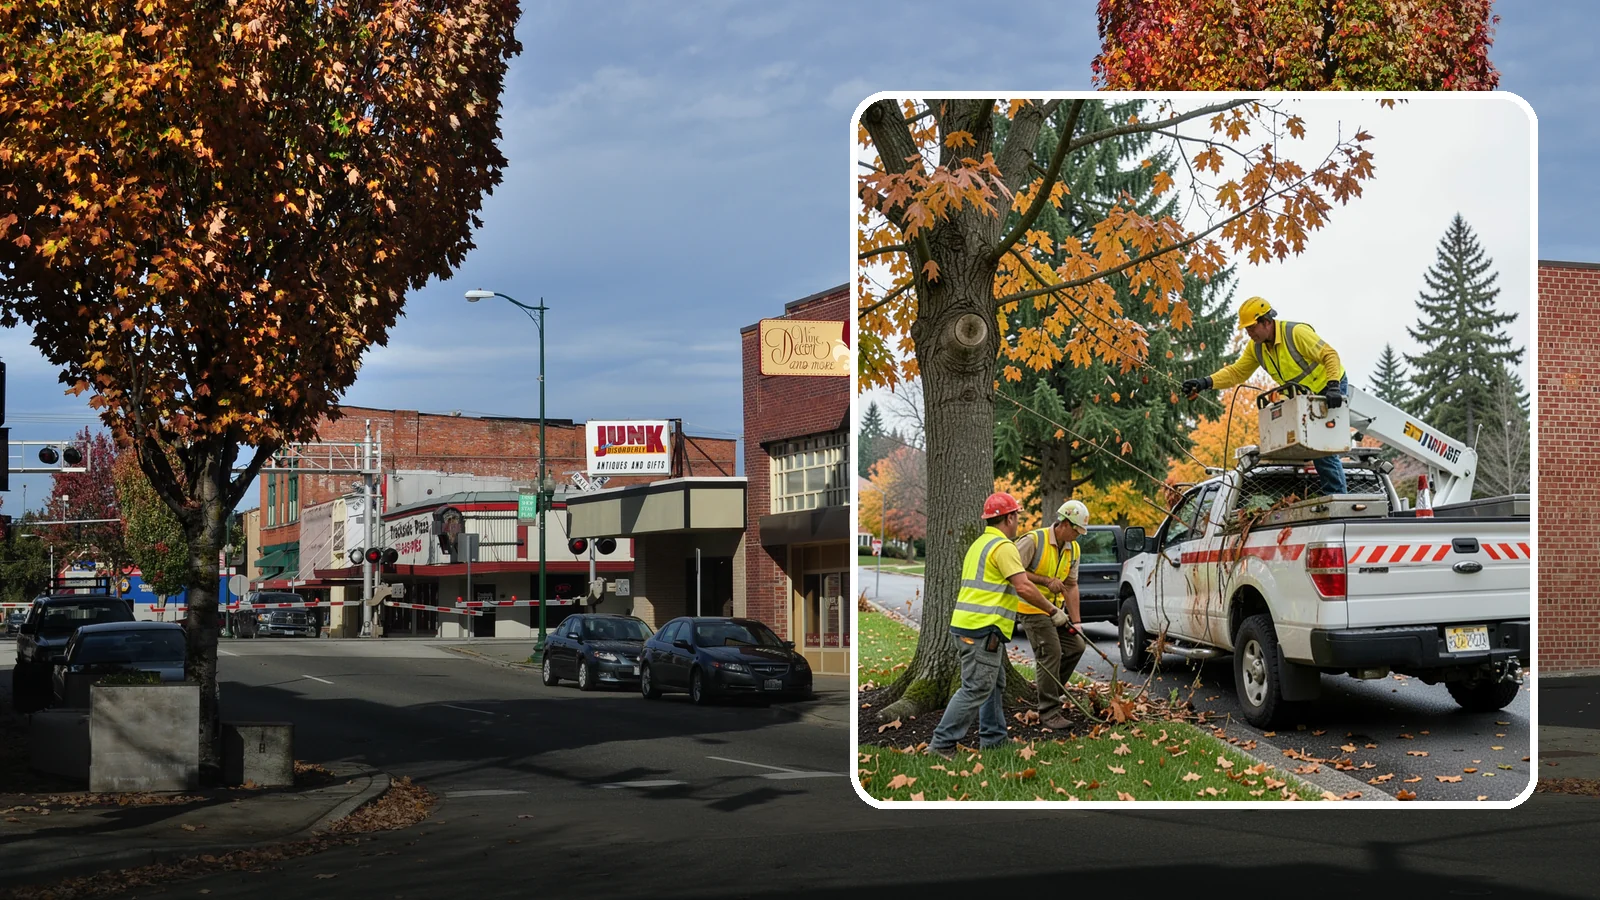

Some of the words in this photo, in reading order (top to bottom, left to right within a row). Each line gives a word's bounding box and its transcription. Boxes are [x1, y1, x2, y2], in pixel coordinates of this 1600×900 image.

[595, 425, 665, 457] JUNK
[607, 446, 646, 454] DISORDERLY
[597, 461, 628, 470] ANTIQUES
[630, 461, 644, 470] AND
[646, 460, 665, 470] GIFTS
[589, 475, 608, 491] SING
[352, 498, 365, 511] CRO
[414, 519, 429, 535] Pizza
